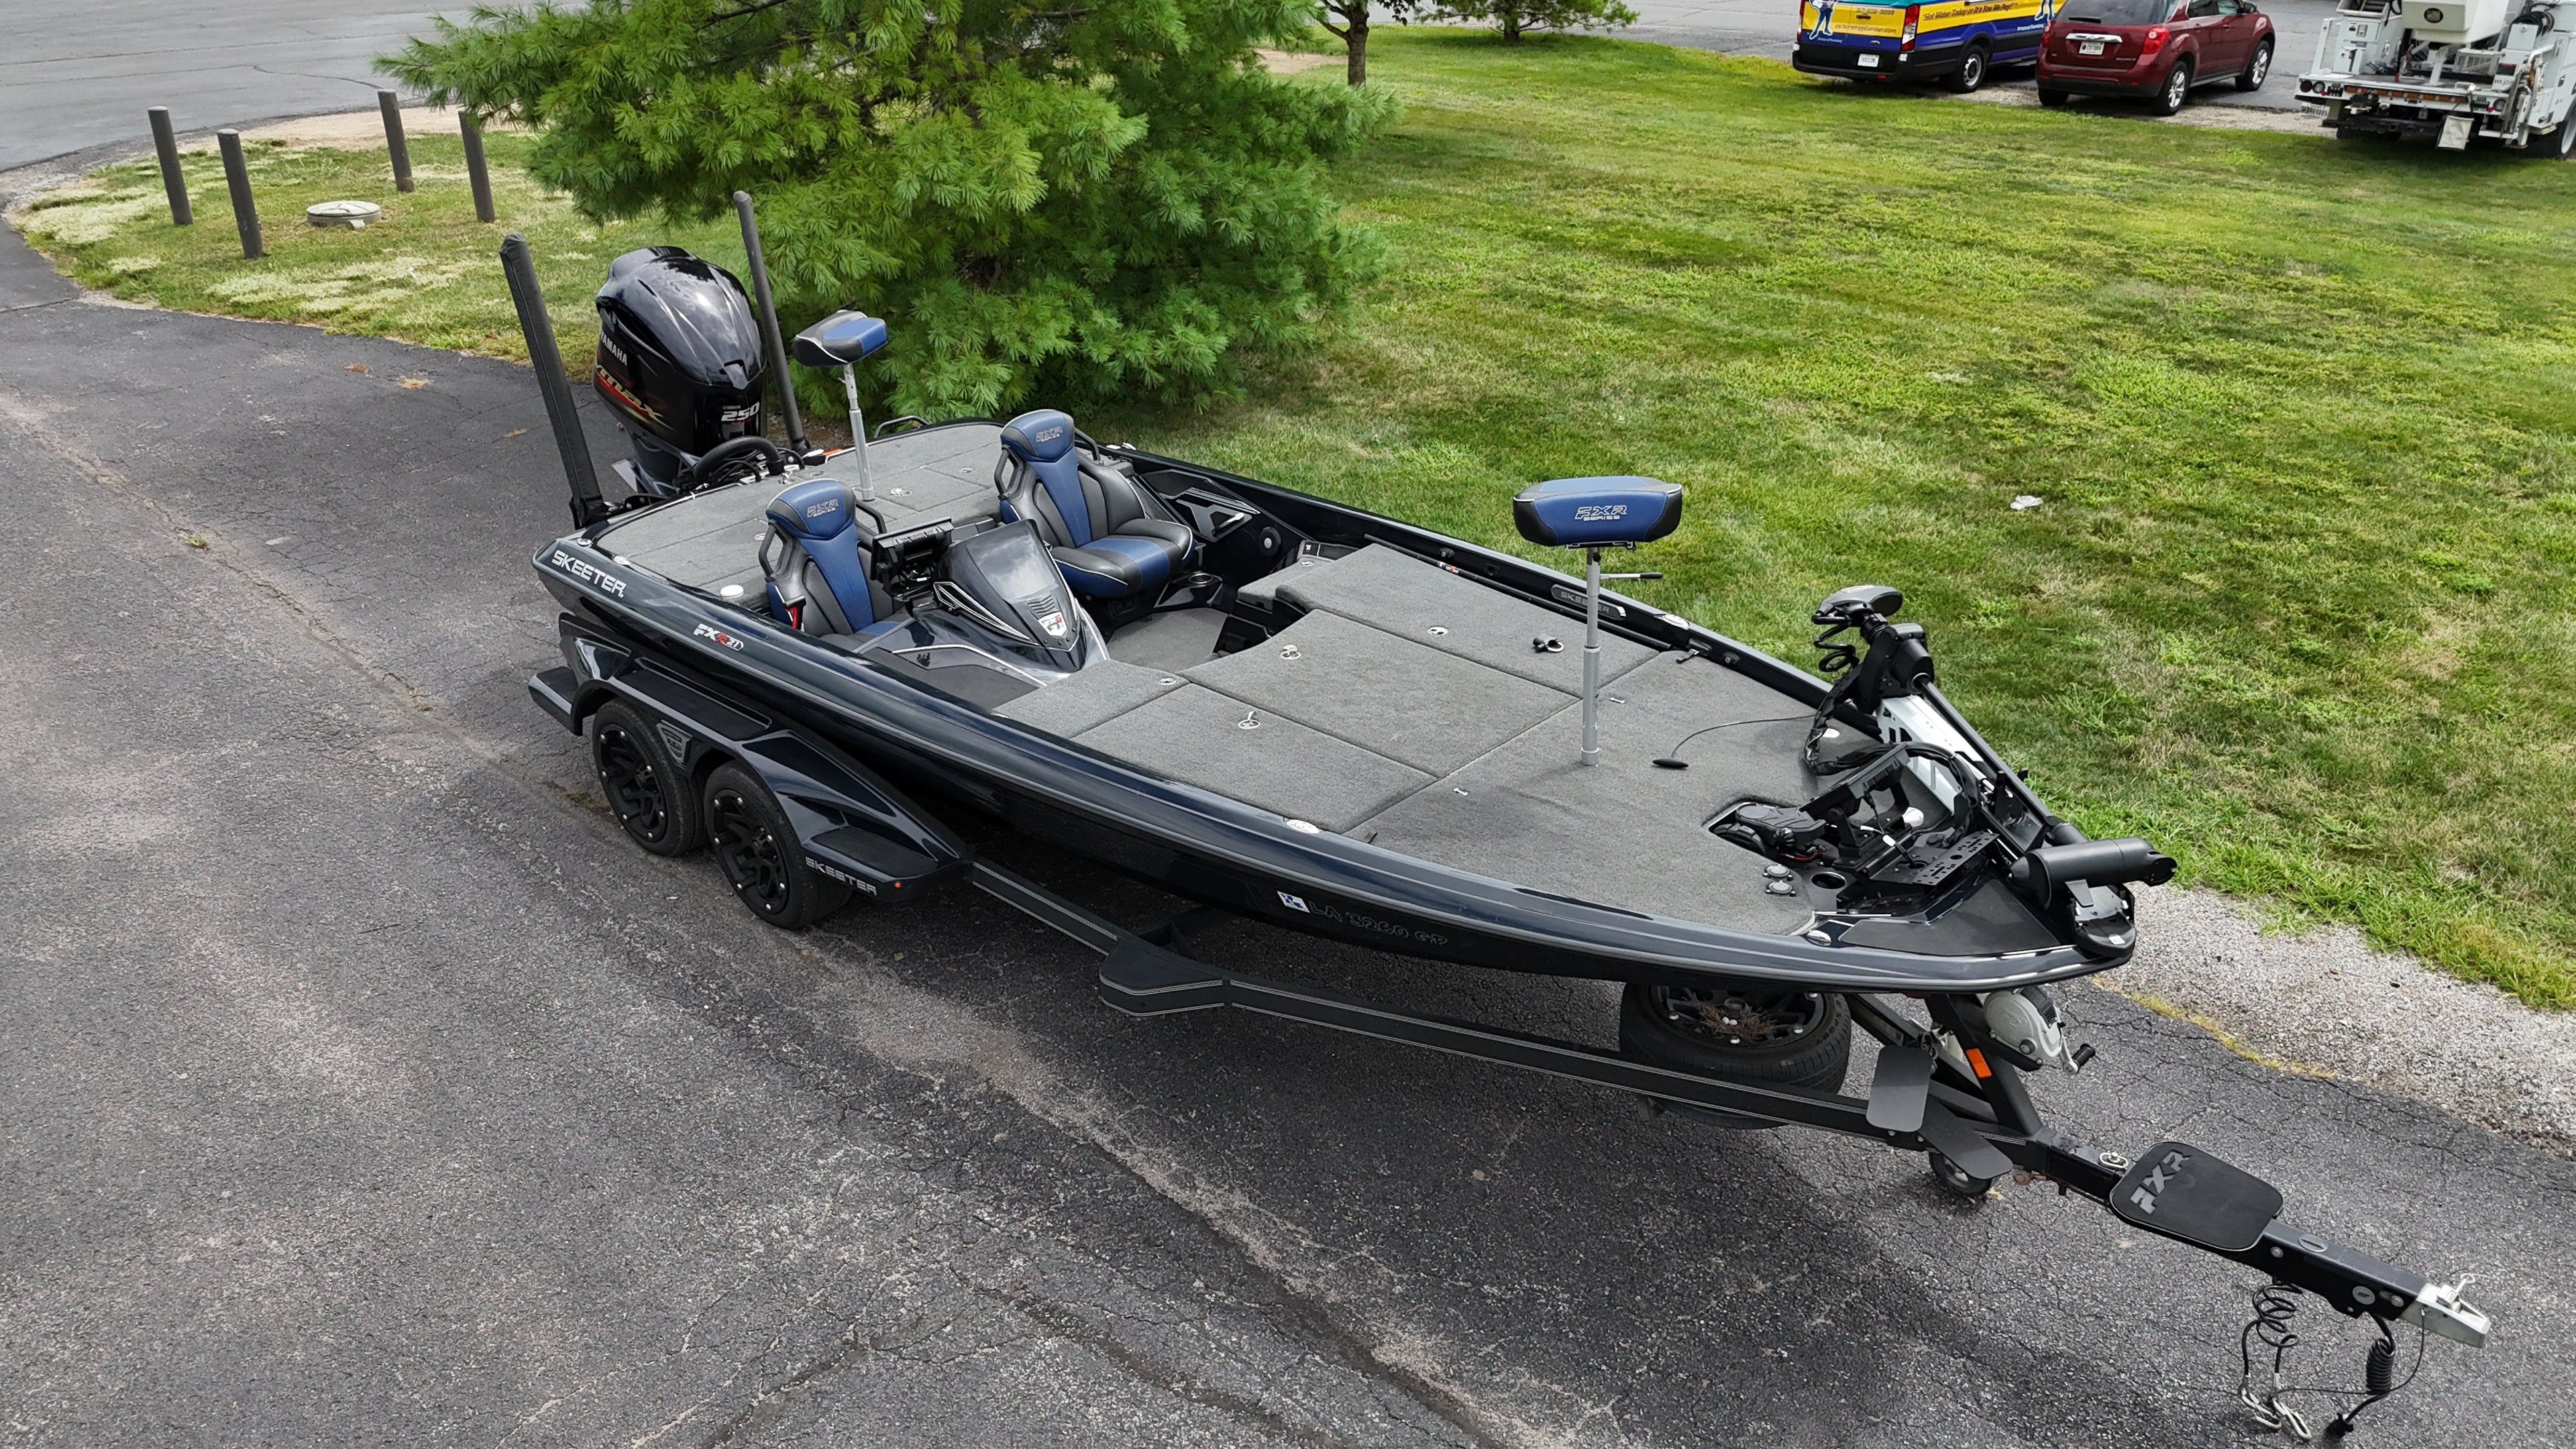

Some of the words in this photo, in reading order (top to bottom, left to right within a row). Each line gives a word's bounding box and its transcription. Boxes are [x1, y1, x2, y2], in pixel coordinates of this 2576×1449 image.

[600, 329, 627, 366] YAMAHA
[721, 402, 760, 421] 250
[807, 499, 839, 518] FXR
[1574, 504, 1627, 520] FXR
[551, 549, 627, 598] SKEETER
[1560, 591, 1609, 614] SKEEER
[805, 856, 877, 896] SKEETER
[1309, 901, 1342, 923] LA
[2130, 1151, 2190, 1215] FXR
